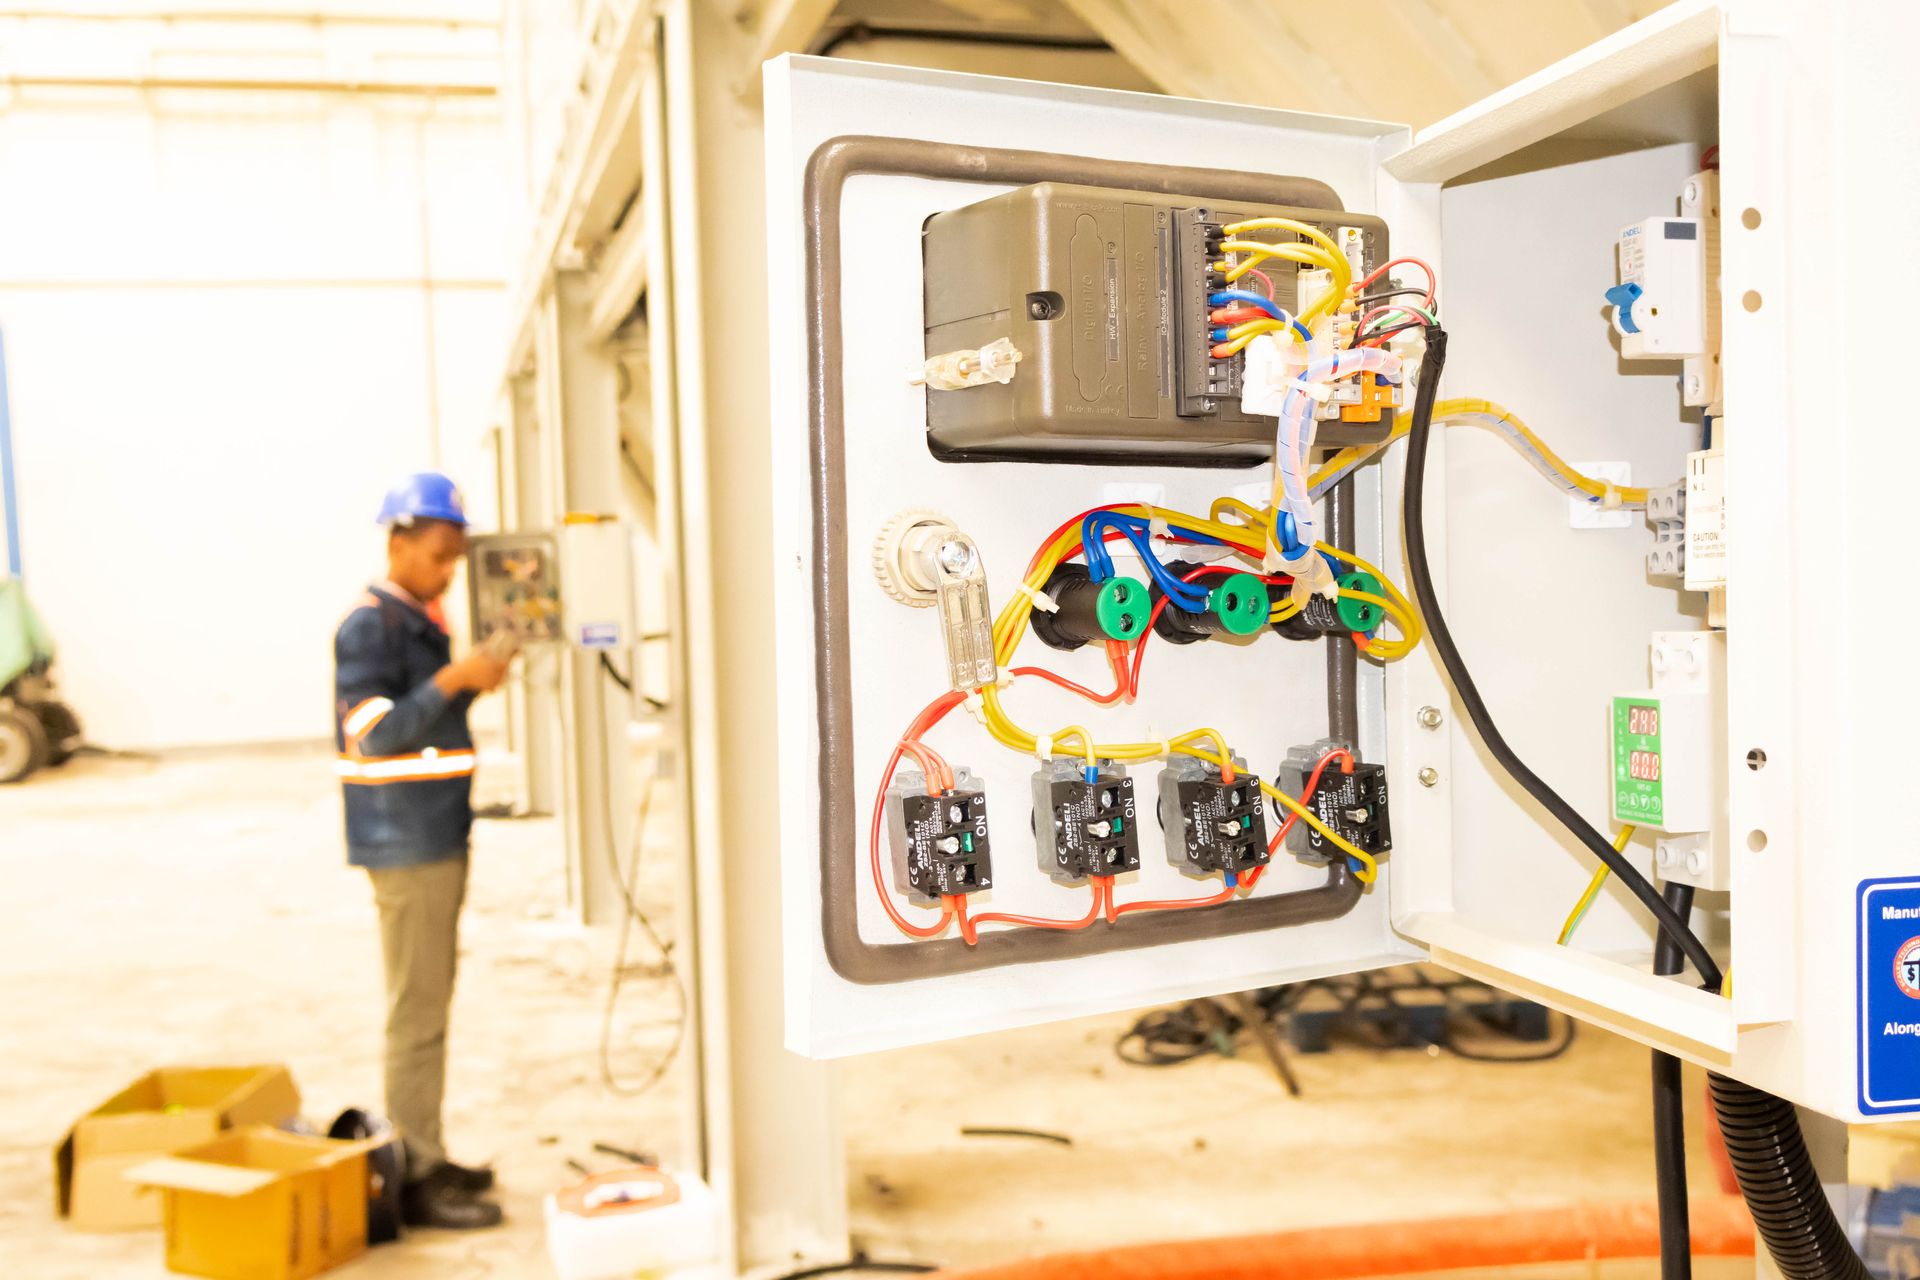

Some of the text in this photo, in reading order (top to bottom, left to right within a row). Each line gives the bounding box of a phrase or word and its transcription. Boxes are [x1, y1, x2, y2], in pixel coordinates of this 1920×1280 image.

[1108, 278, 1117, 318] Expansion
[1250, 779, 1259, 787] 3
[1378, 785, 1386, 805] NO
[1122, 780, 1138, 864] 3 NO 4
[1193, 801, 1205, 846] ANDELI
[1252, 796, 1262, 815] NO
[1318, 790, 1328, 828] NDELI
[914, 820, 924, 870] ANDELI
[974, 796, 990, 886] 3 NO 4
[1063, 802, 1074, 850] ANDELI
[1883, 1022, 1920, 1037] Along
